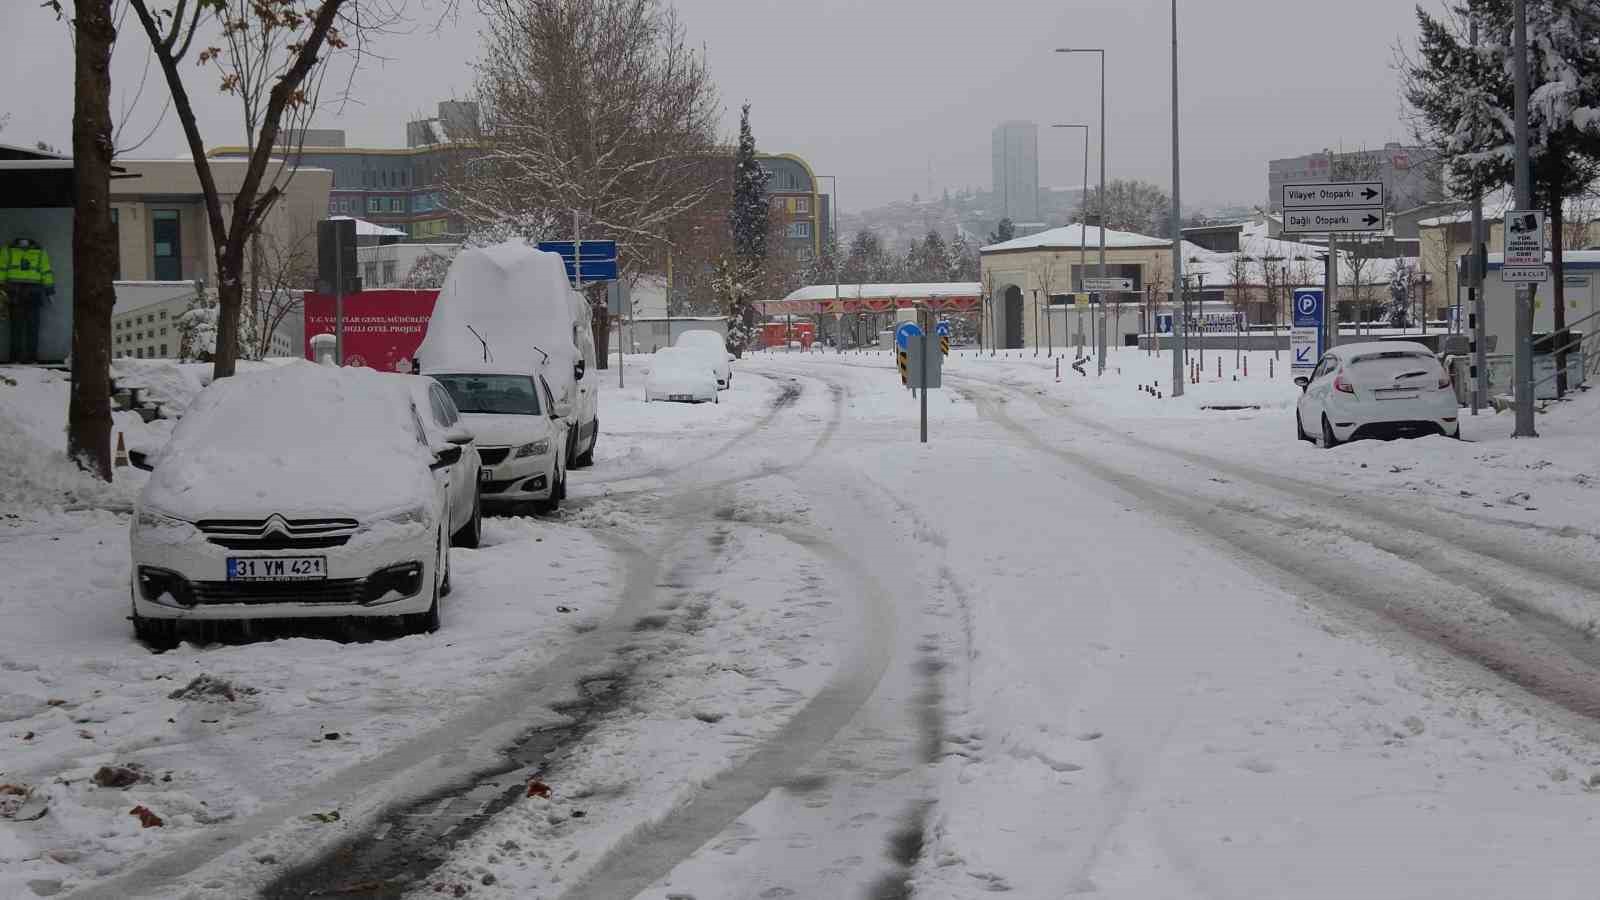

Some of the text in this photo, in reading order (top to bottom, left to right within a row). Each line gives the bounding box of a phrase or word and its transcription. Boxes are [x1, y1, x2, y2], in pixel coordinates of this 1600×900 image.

[1288, 189, 1354, 201] Vilayet Otoparkı
[238, 560, 255, 576] 31
[264, 560, 285, 576] YM
